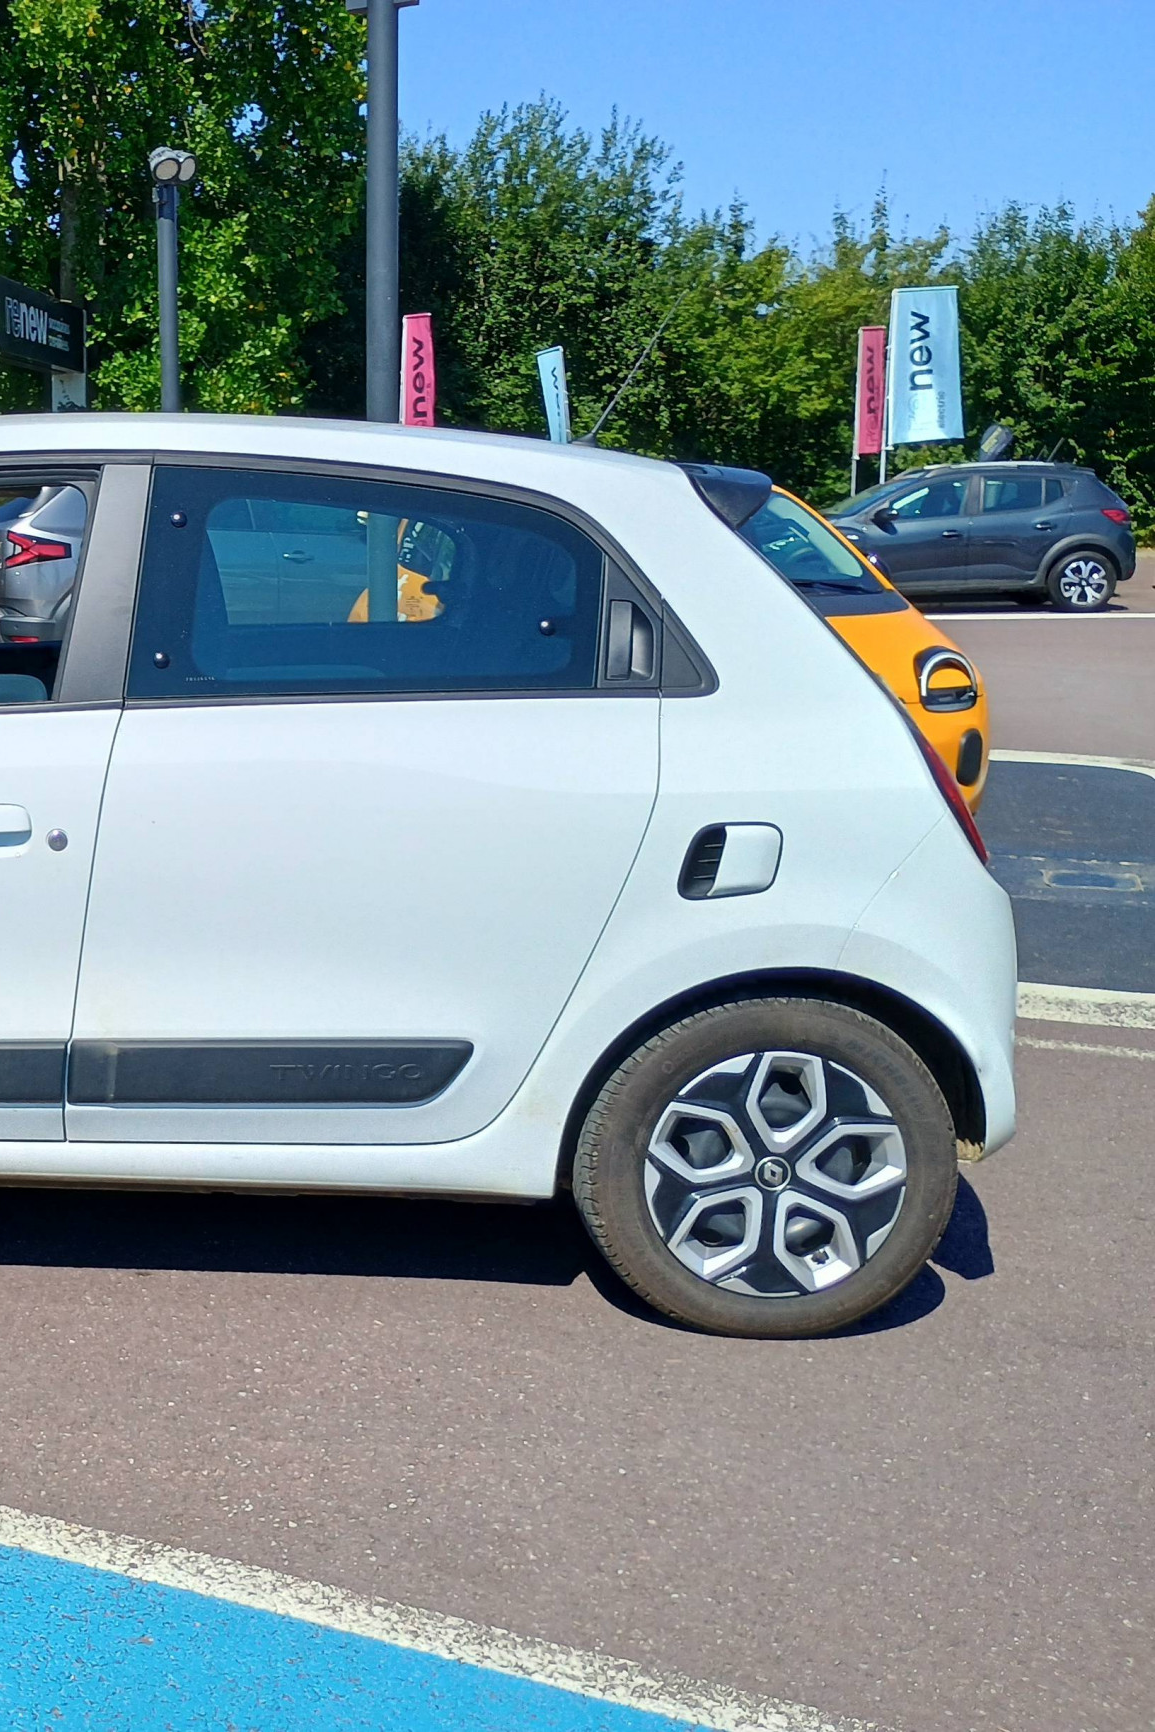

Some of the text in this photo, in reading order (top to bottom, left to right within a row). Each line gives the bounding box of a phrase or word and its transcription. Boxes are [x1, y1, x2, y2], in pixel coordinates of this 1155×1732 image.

[5, 296, 48, 345] renew
[413, 336, 428, 425] new
[270, 1063, 423, 1080] TWINGO
